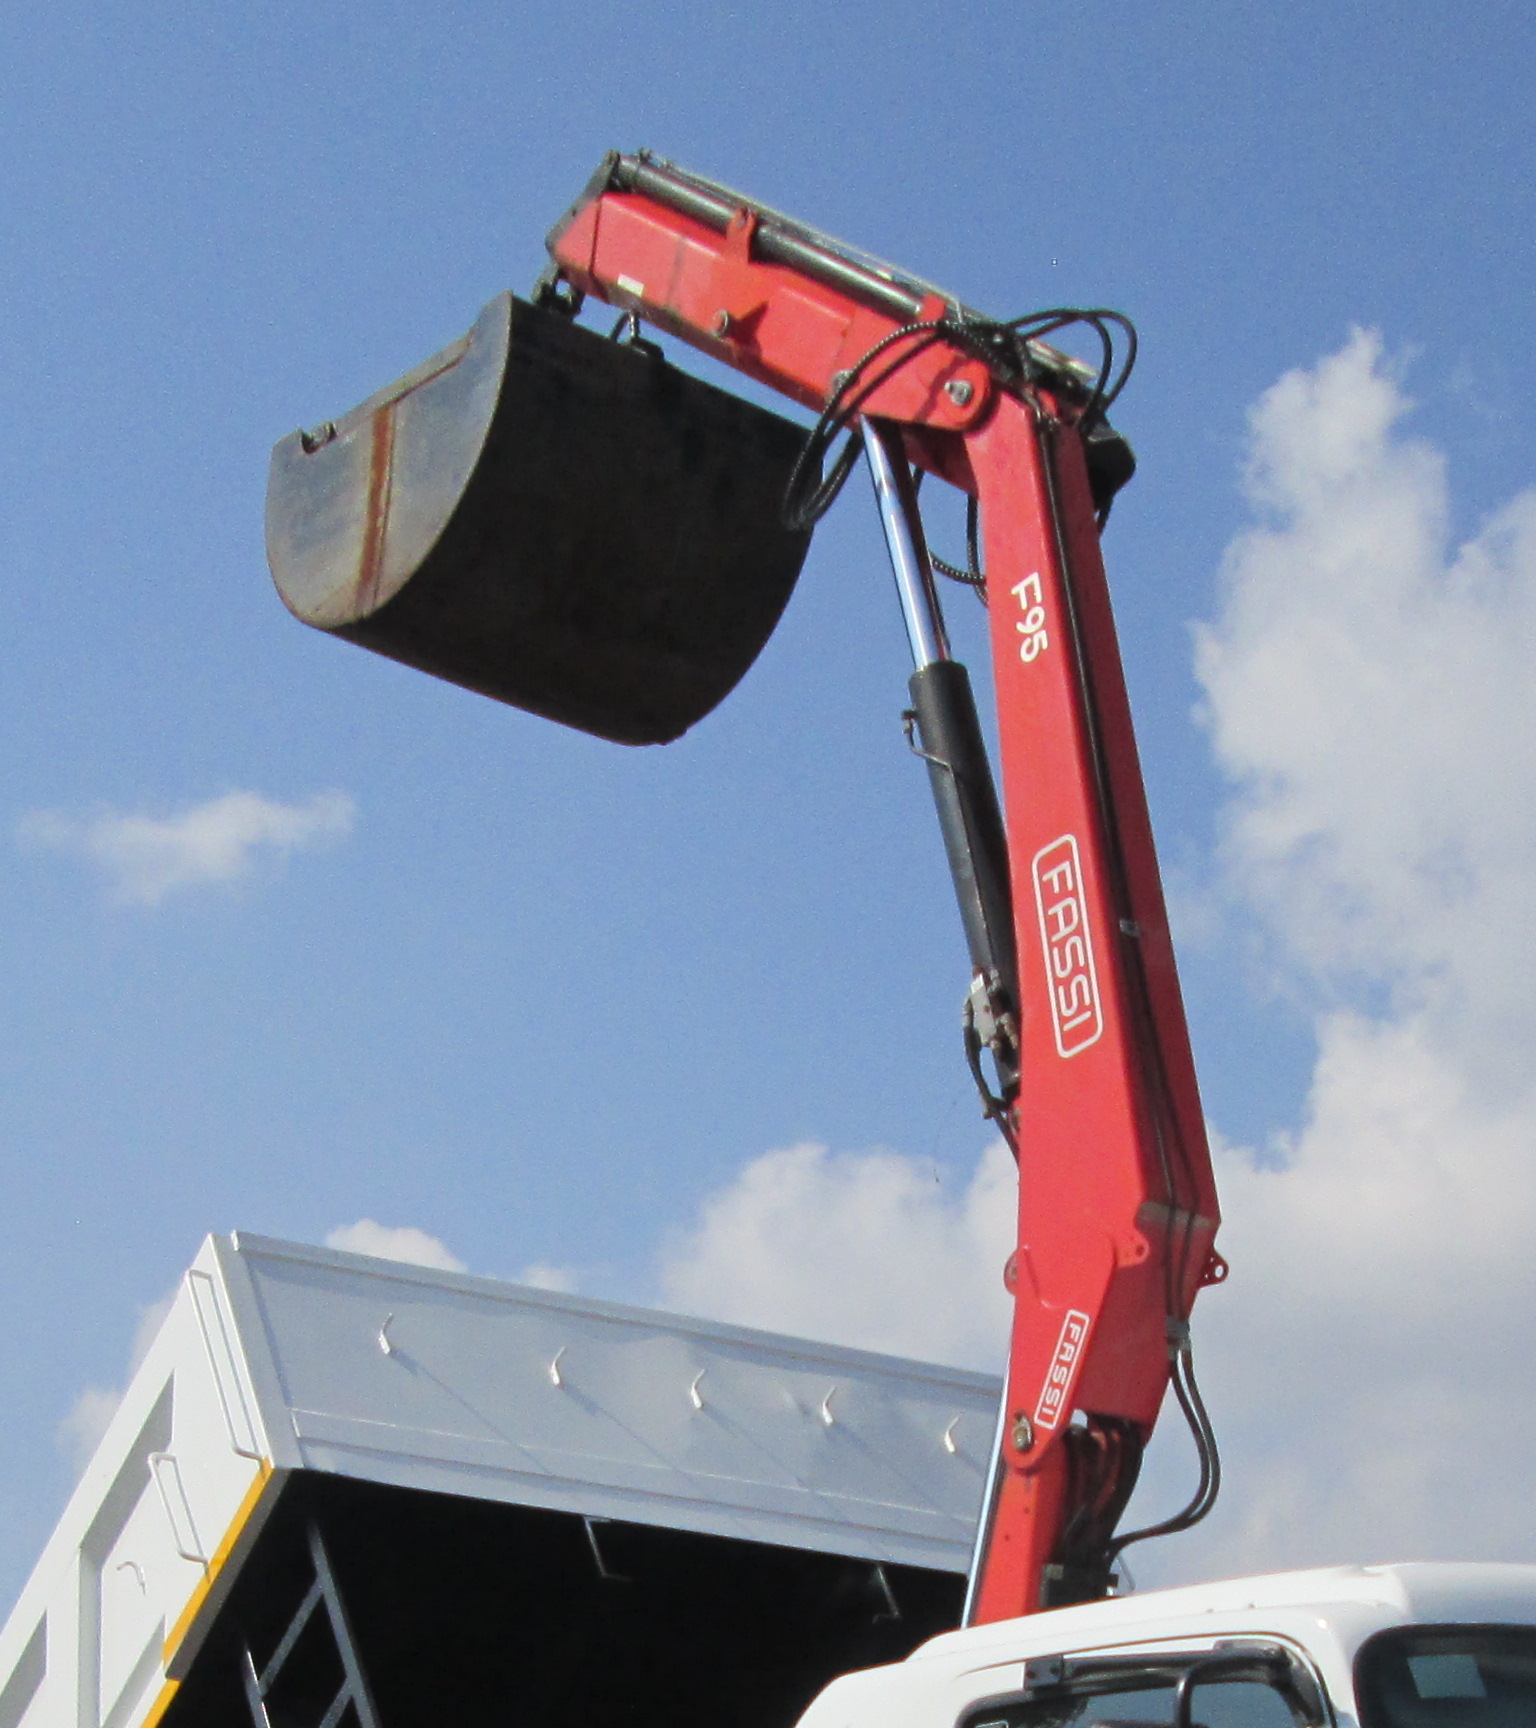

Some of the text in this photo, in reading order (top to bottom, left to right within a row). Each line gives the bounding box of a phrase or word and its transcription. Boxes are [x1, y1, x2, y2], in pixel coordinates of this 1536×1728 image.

[1010, 571, 1048, 663] F95
[1041, 860, 1092, 1032] FASSI
[1041, 1322, 1082, 1416] FASSI
